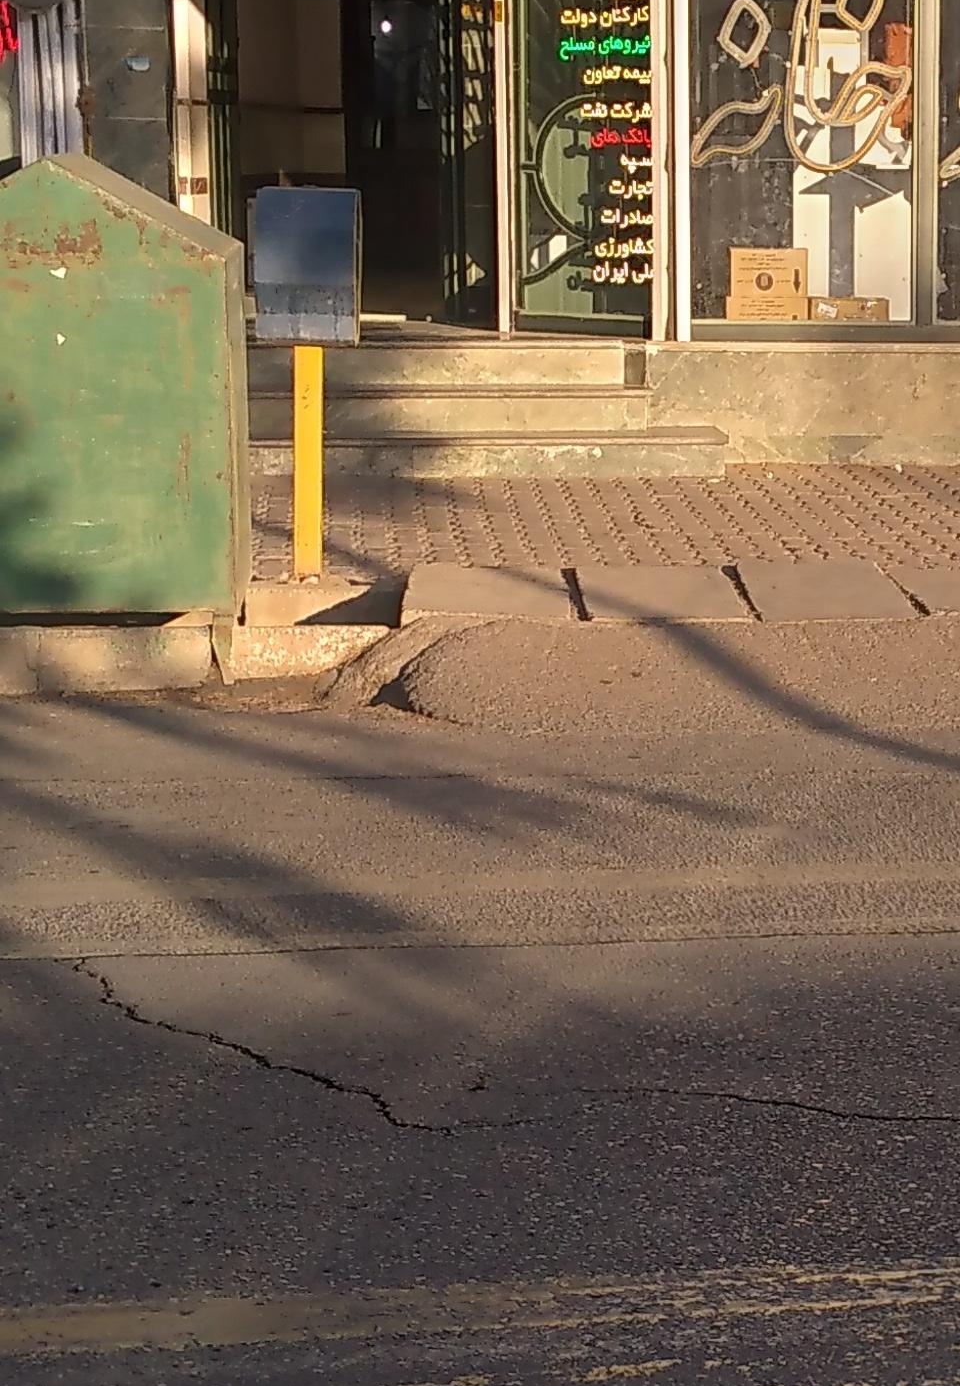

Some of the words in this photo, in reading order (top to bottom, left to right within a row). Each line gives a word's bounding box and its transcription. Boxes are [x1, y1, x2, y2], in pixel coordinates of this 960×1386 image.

[560, 8, 598, 28] دولت
[599, 5, 649, 28] کارکنان
[559, 36, 596, 61] مسلح
[598, 34, 651, 55] نیروهای
[583, 65, 622, 85] تعاون
[622, 70, 652, 85] بیمه
[580, 101, 608, 119] نفت
[609, 101, 653, 124] شرکت
[608, 179, 654, 201] تجارت
[600, 208, 654, 229] صادرات
[594, 236, 655, 258] کشاورزی
[592, 260, 630, 285] ایران
